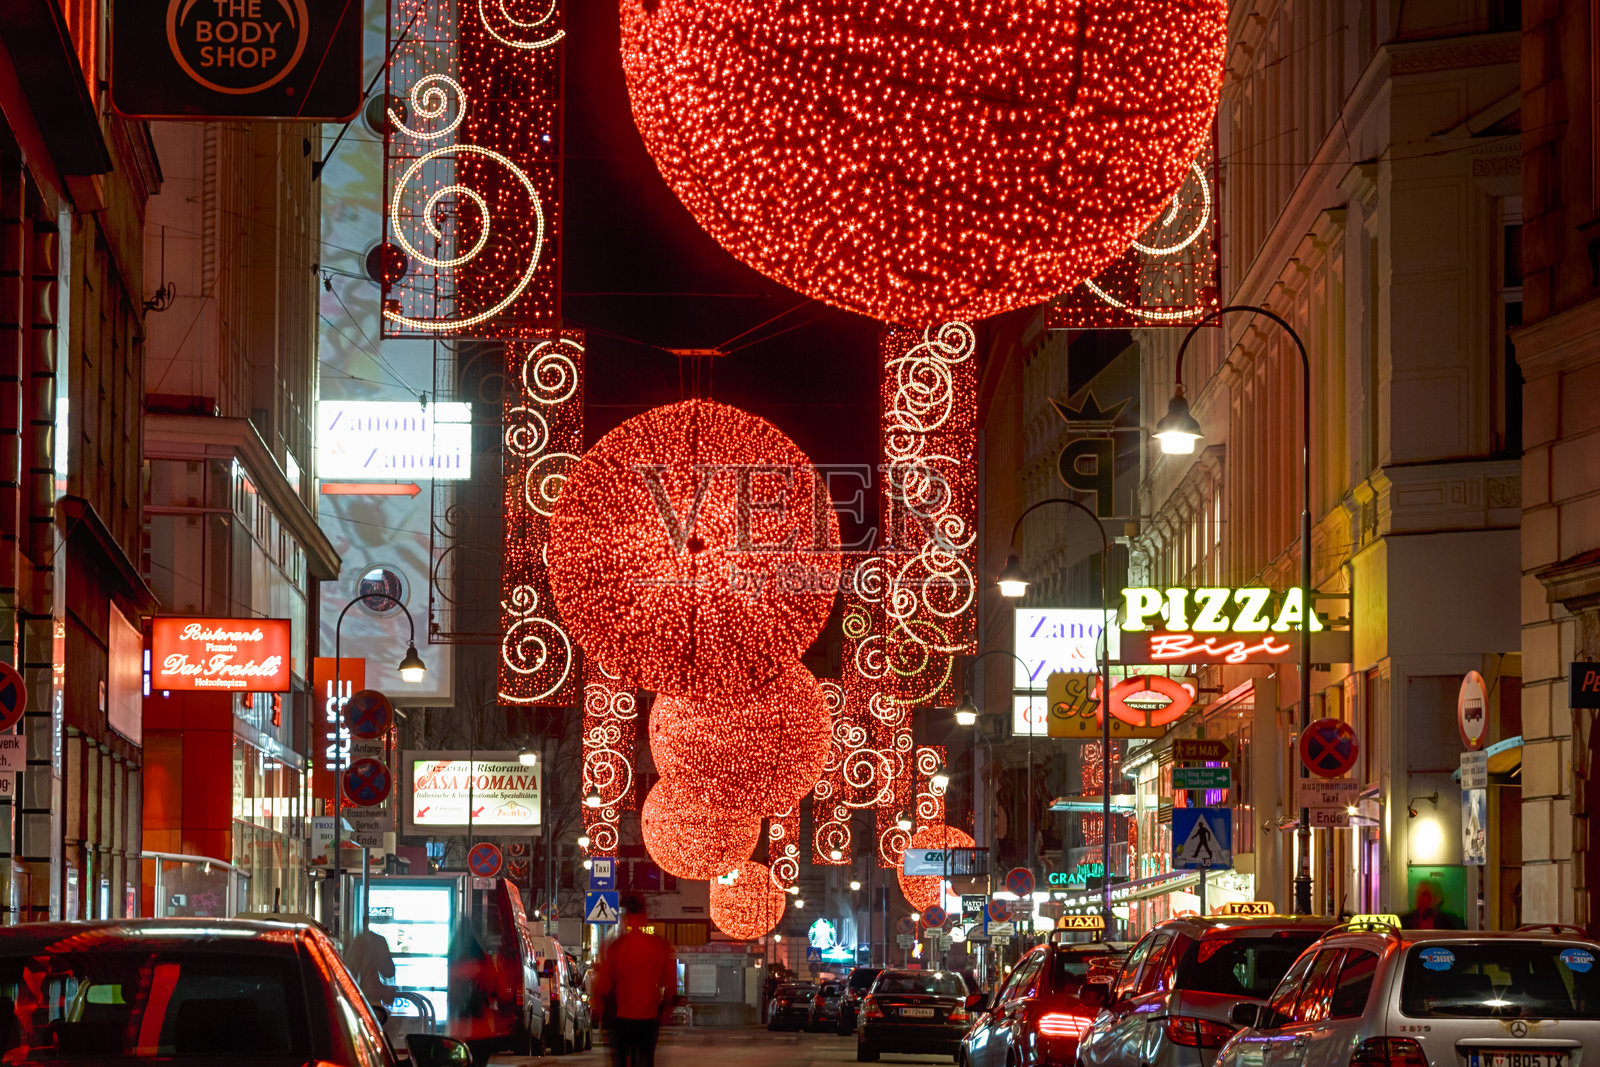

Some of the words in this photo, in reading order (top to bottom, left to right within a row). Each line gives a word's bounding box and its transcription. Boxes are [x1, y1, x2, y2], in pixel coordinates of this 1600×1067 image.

[213, 0, 262, 18] THE
[196, 20, 282, 44] BODY
[200, 46, 277, 68] SHOP
[328, 409, 426, 432] Zanoni
[362, 446, 461, 469] Zanoni
[1121, 587, 1324, 632] PIZZA
[179, 622, 264, 641] Ristorante
[205, 643, 238, 652] Pizzeria
[1150, 634, 1291, 664] Bizi
[160, 653, 206, 676] Dai
[203, 653, 282, 677] Fratelli
[194, 678, 248, 688] Holzofenpizza
[354, 743, 381, 756] Anfang
[1199, 744, 1219, 757] MAK
[477, 763, 530, 773] Ristorante
[416, 775, 458, 790] CASA
[464, 775, 538, 790] ROMANA
[1302, 782, 1358, 793] ausgenommen
[499, 791, 538, 800] Spezialitäten
[1321, 793, 1339, 803] Taxi
[1316, 812, 1343, 823] Ende
[355, 821, 379, 829] Bereich
[356, 835, 378, 845] Ende
[595, 863, 610, 873] Taxi
[1231, 904, 1269, 913] TAXI
[1064, 917, 1099, 927] TAXI
[1482, 1052, 1495, 1067] W
[1505, 1053, 1541, 1067] 1805
[1545, 1054, 1565, 1067] TX
